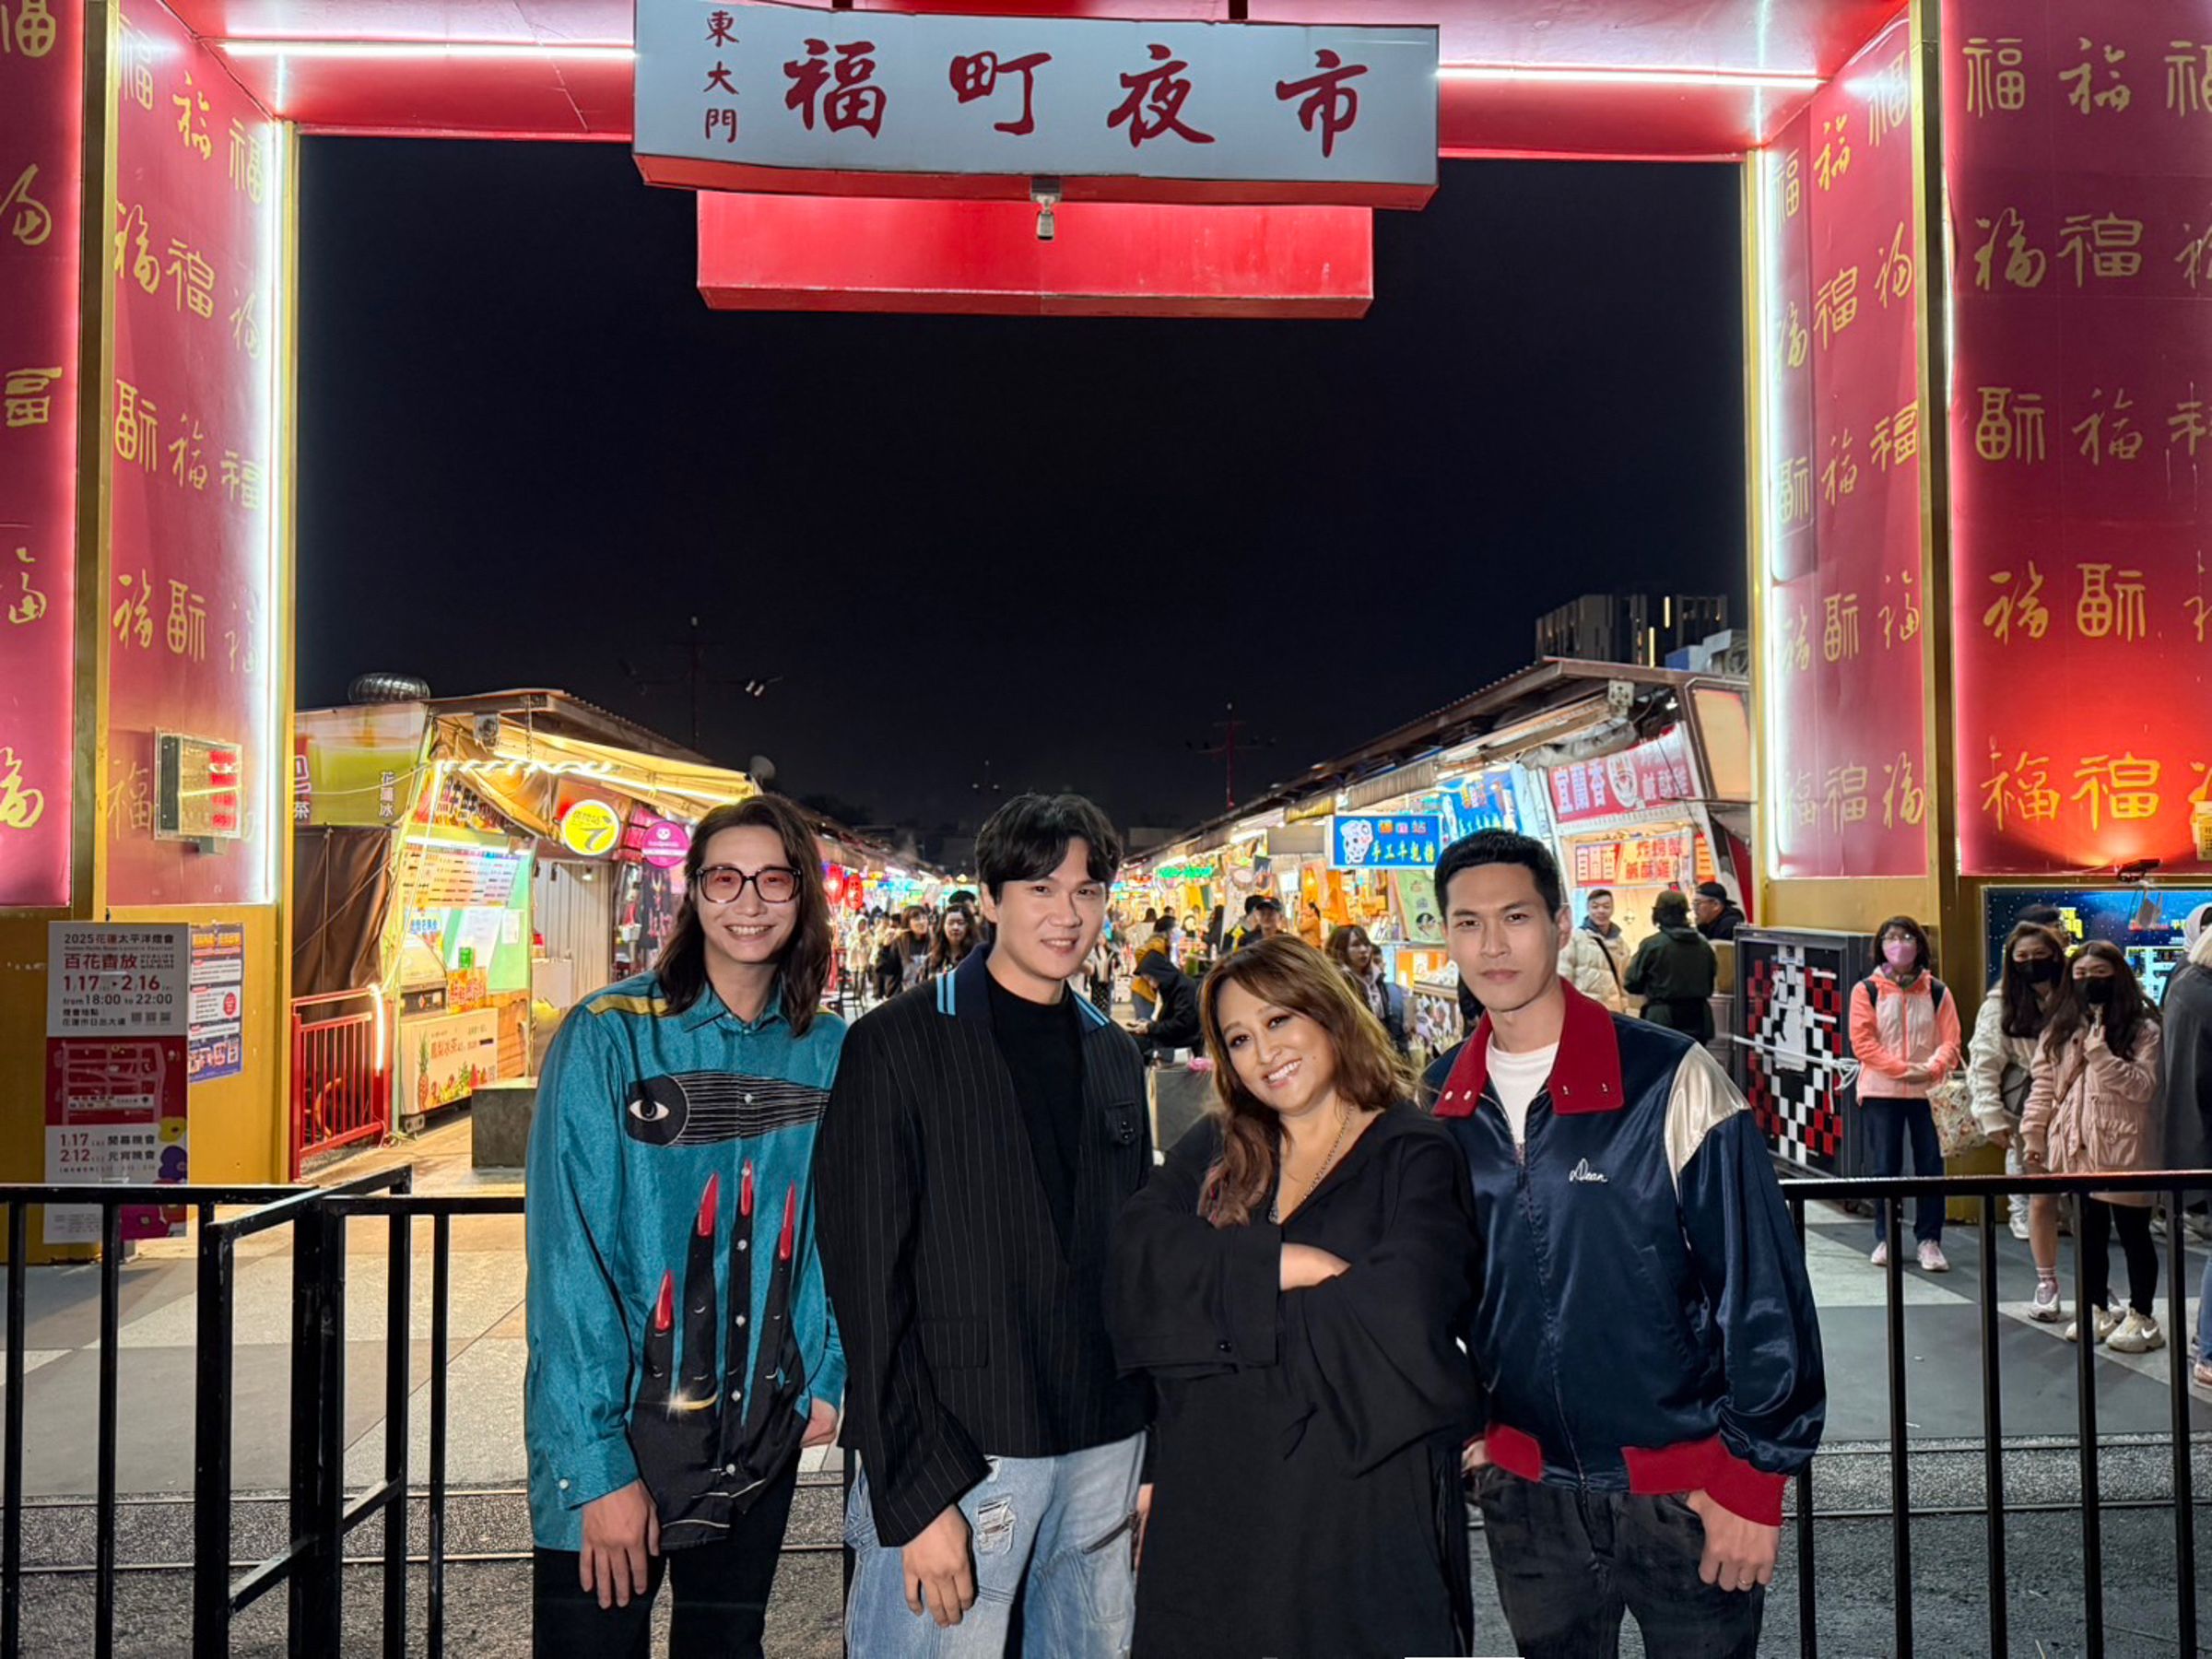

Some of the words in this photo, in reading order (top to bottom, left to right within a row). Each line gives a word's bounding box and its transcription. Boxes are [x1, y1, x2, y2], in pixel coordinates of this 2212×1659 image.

[703, 9, 741, 145] 東大門
[783, 38, 1370, 159] 福町夜市
[1962, 37, 2026, 118] 福
[166, 238, 215, 319] 福
[2057, 212, 2144, 288] 福
[1813, 265, 1858, 350] 福
[1981, 748, 2062, 832] 福
[2071, 751, 2161, 832] 福
[64, 934, 174, 944] 2025花蓮太平洋燈會
[86, 994, 121, 1006] 18:00
[135, 994, 173, 1006] 22:00
